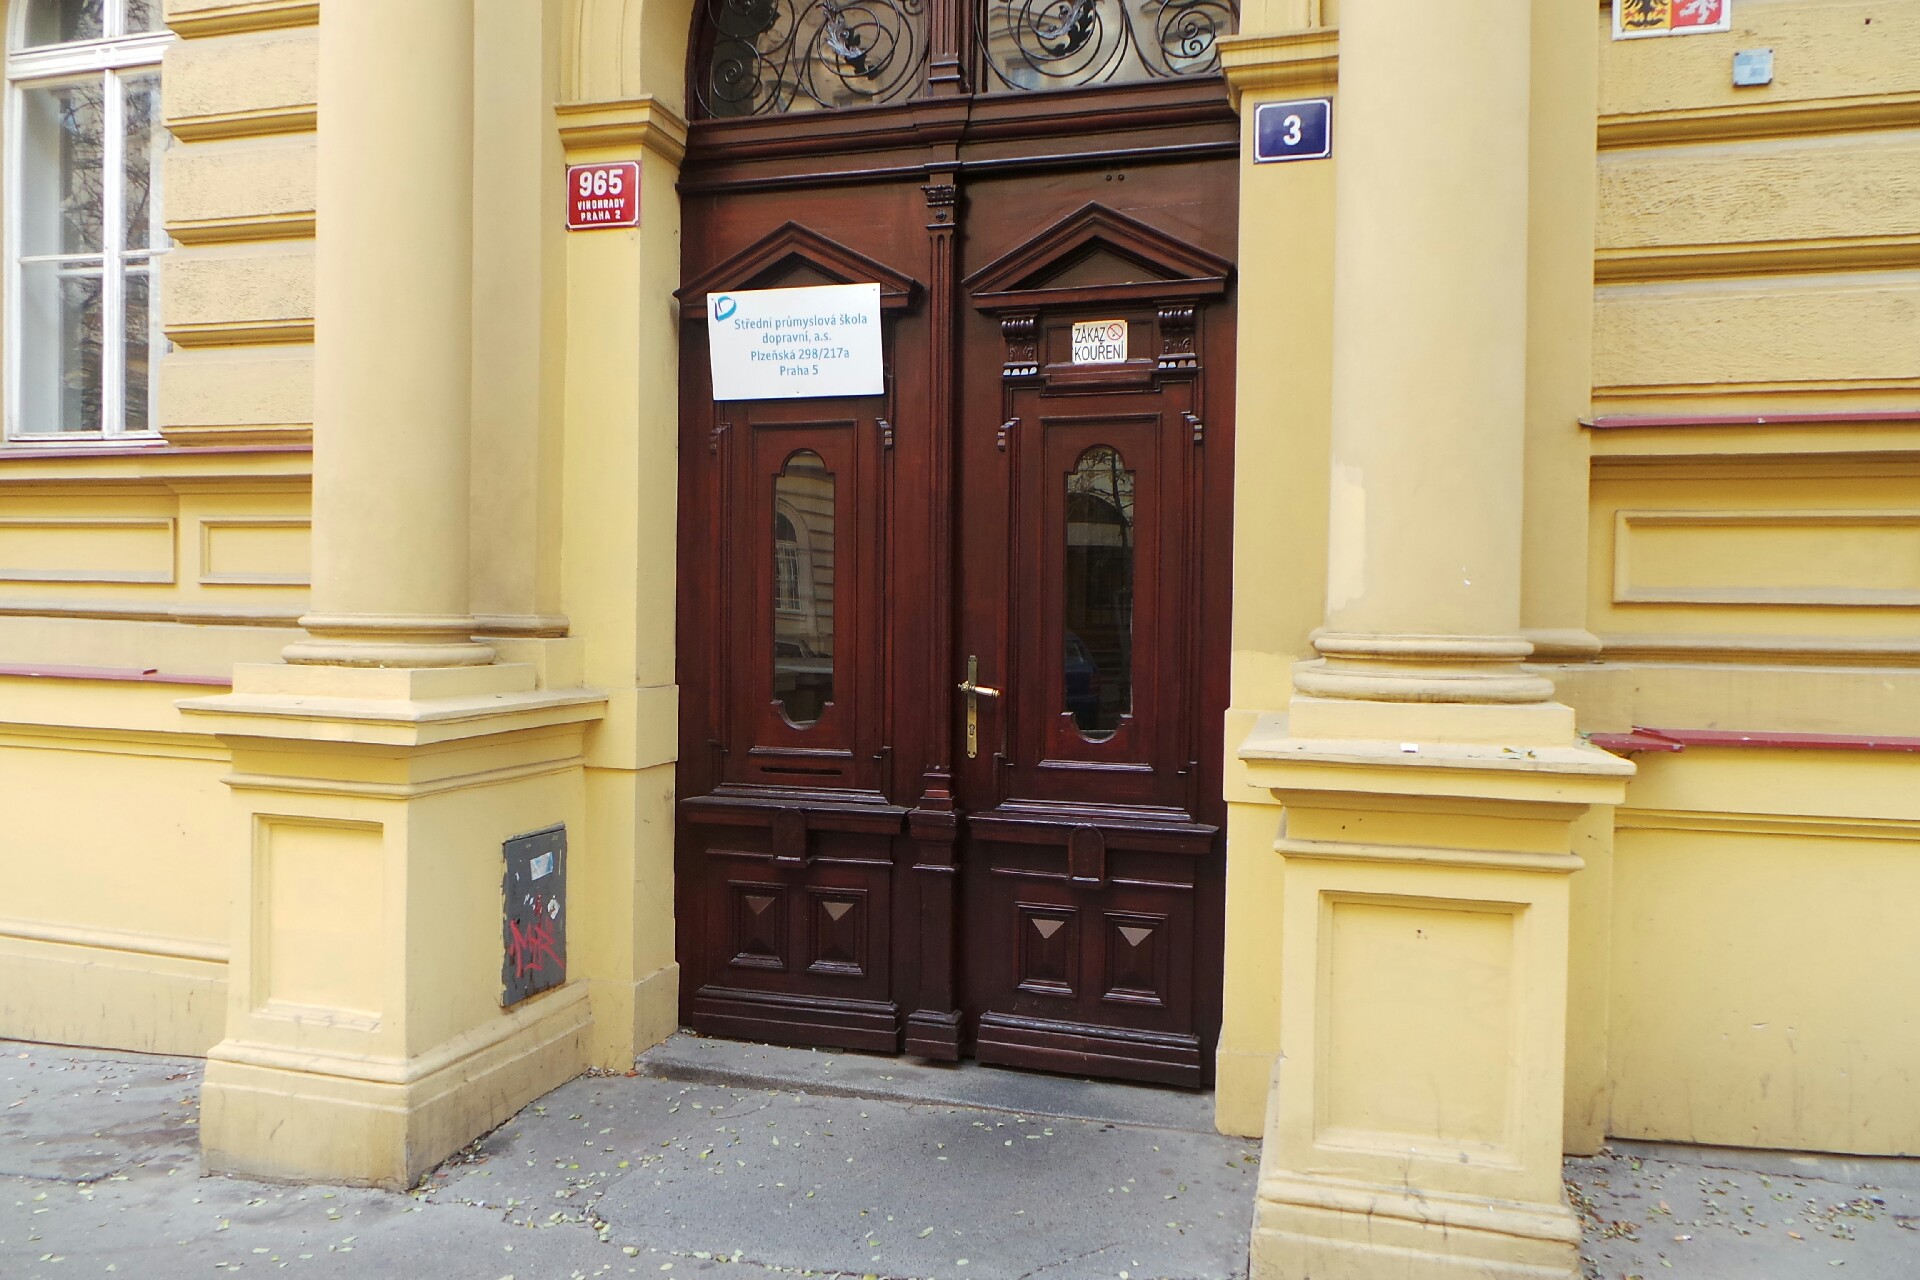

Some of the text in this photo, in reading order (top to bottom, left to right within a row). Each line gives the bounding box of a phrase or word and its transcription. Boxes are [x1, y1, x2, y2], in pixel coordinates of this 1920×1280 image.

[1283, 114, 1302, 146] 3
[579, 168, 623, 197] 965
[577, 198, 625, 211] VINOHRADY
[580, 209, 621, 222] PRAHA 2
[734, 312, 868, 331] Střední průmyslová škola
[762, 331, 832, 346] dopravní, a.s.
[1074, 325, 1106, 344] ZÁKAZ
[751, 347, 850, 362] Plzeňská 298/217a
[1074, 341, 1124, 361] KOUŘENÍ
[779, 364, 819, 376] Praha 5
